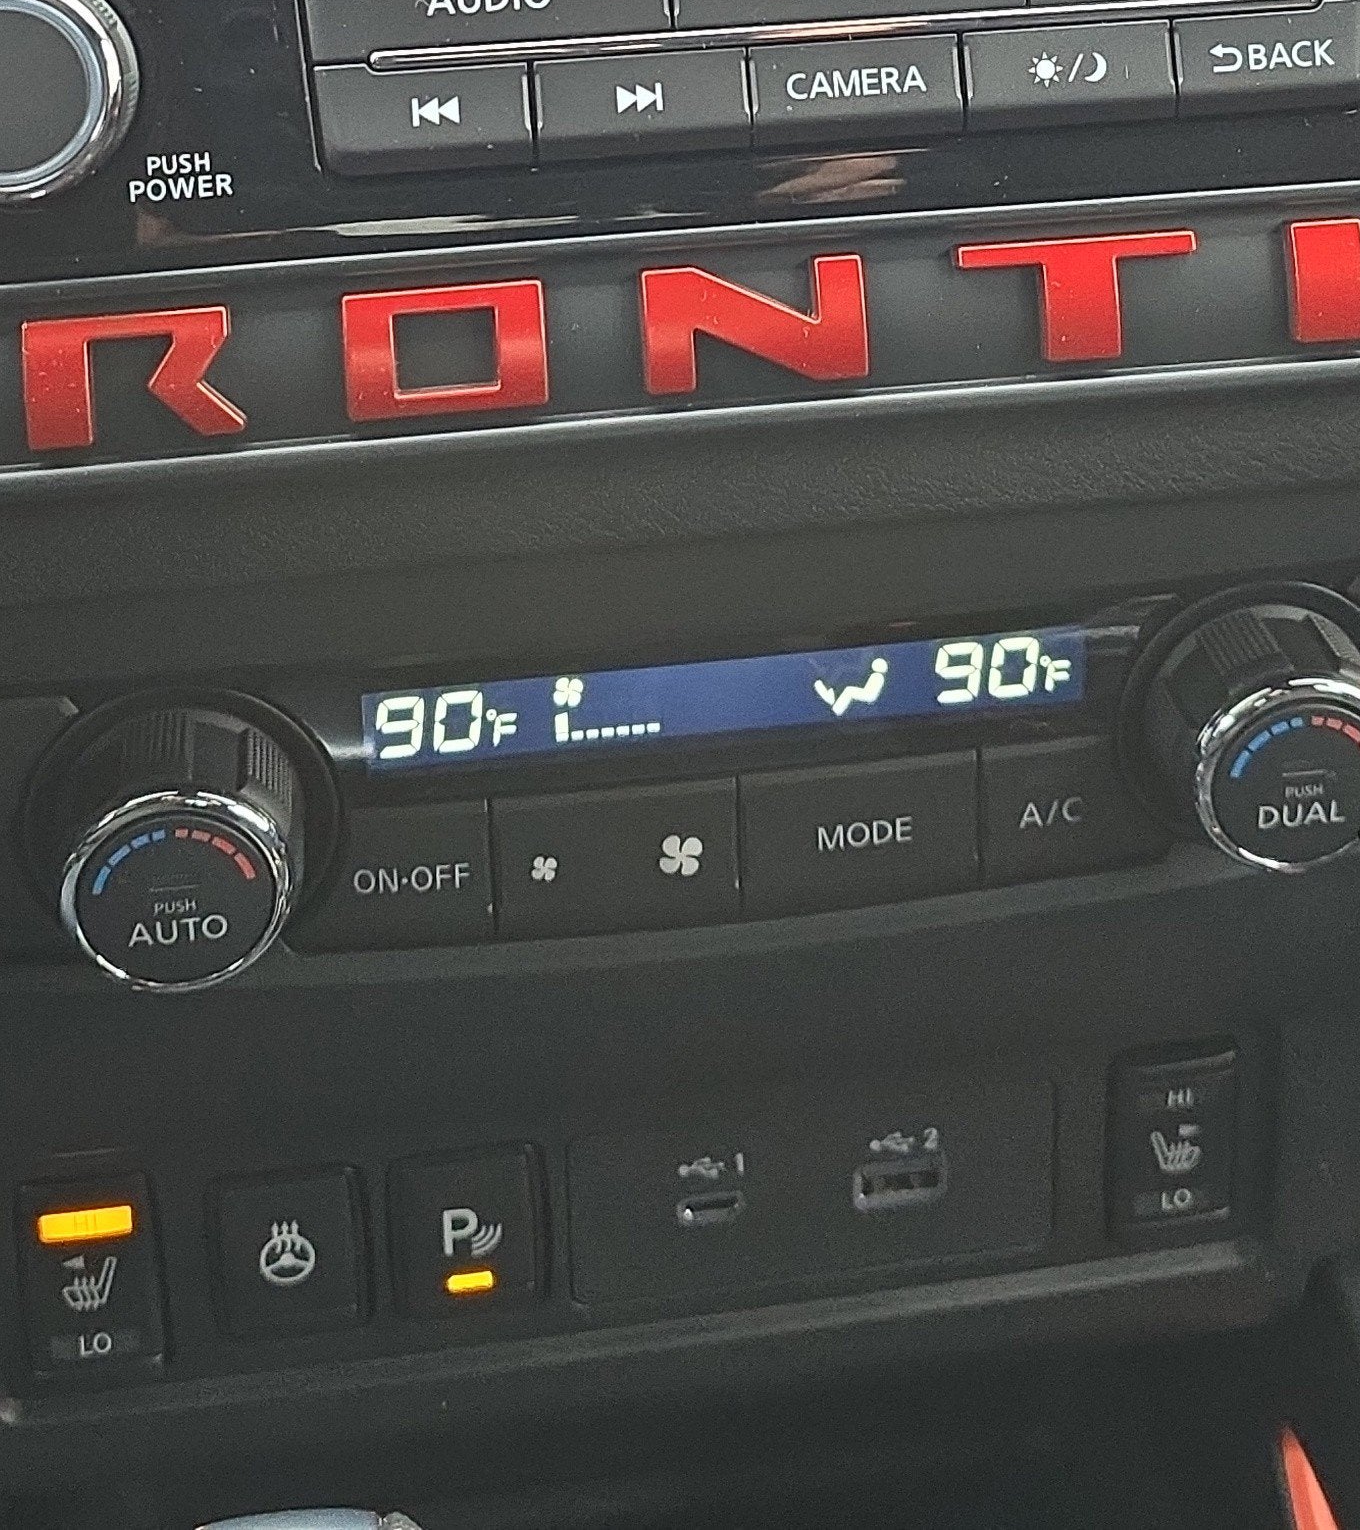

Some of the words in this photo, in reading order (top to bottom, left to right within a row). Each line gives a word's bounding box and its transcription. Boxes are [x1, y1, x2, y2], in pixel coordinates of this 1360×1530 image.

[1249, 39, 1335, 71] BACK
[787, 65, 927, 101] CAMERA
[146, 152, 212, 176] PUSH
[129, 174, 234, 203] POWER
[1285, 784, 1324, 798] PUSH
[1020, 796, 1083, 829] A/C
[1258, 799, 1346, 829] DUAL
[817, 816, 912, 852] MODE
[154, 898, 197, 916] PUSH
[128, 914, 228, 948] AUTO
[1168, 1087, 1194, 1107] HI
[1161, 1188, 1192, 1211] LO
[442, 1208, 479, 1257] P
[79, 1332, 112, 1356] LO
